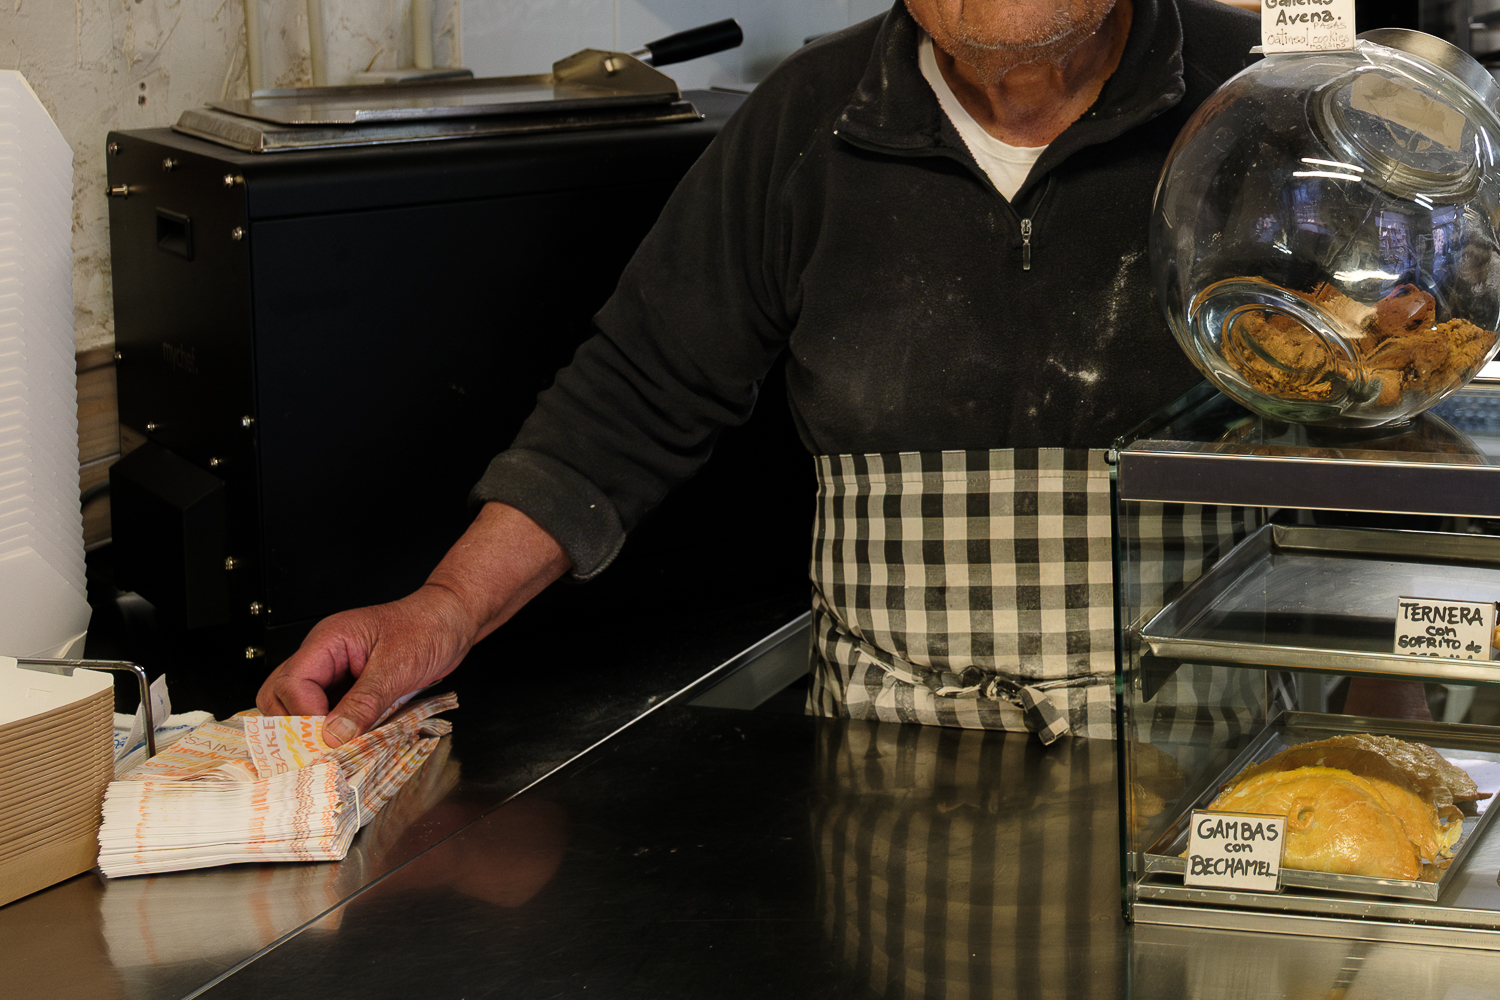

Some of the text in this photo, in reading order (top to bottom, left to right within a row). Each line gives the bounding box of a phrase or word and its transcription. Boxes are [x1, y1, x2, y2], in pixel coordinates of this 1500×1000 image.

[1400, 603, 1484, 627] TERNERA
[1425, 625, 1457, 638] con
[1465, 640, 1482, 654] de
[262, 716, 289, 775] BAKE
[1197, 819, 1279, 842] GAMBAS
[1224, 842, 1254, 853] con
[1190, 855, 1277, 879] BECHAMEL
